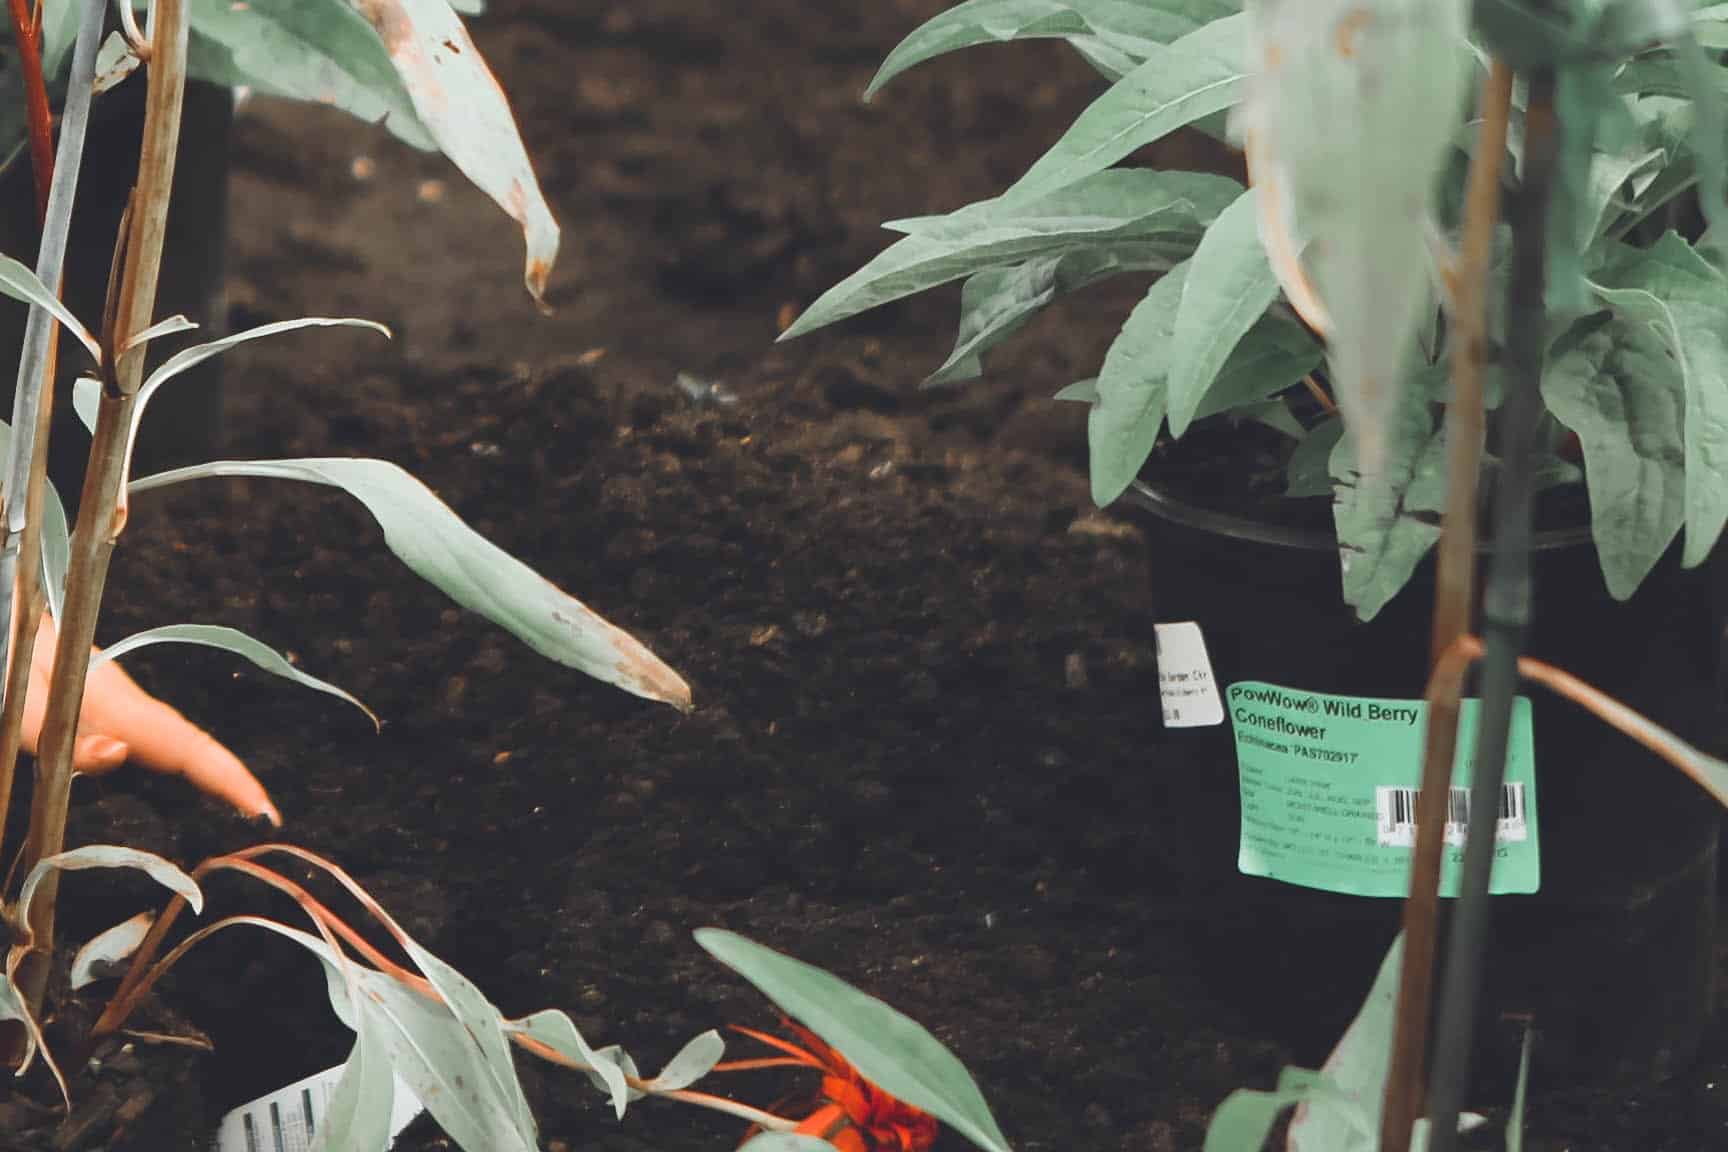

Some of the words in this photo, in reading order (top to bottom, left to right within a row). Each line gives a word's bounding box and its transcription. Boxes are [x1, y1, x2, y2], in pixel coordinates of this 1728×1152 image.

[1235, 707, 1327, 741] Coneflower
[1323, 699, 1361, 719] Wild
[1368, 703, 1419, 726] Berry
